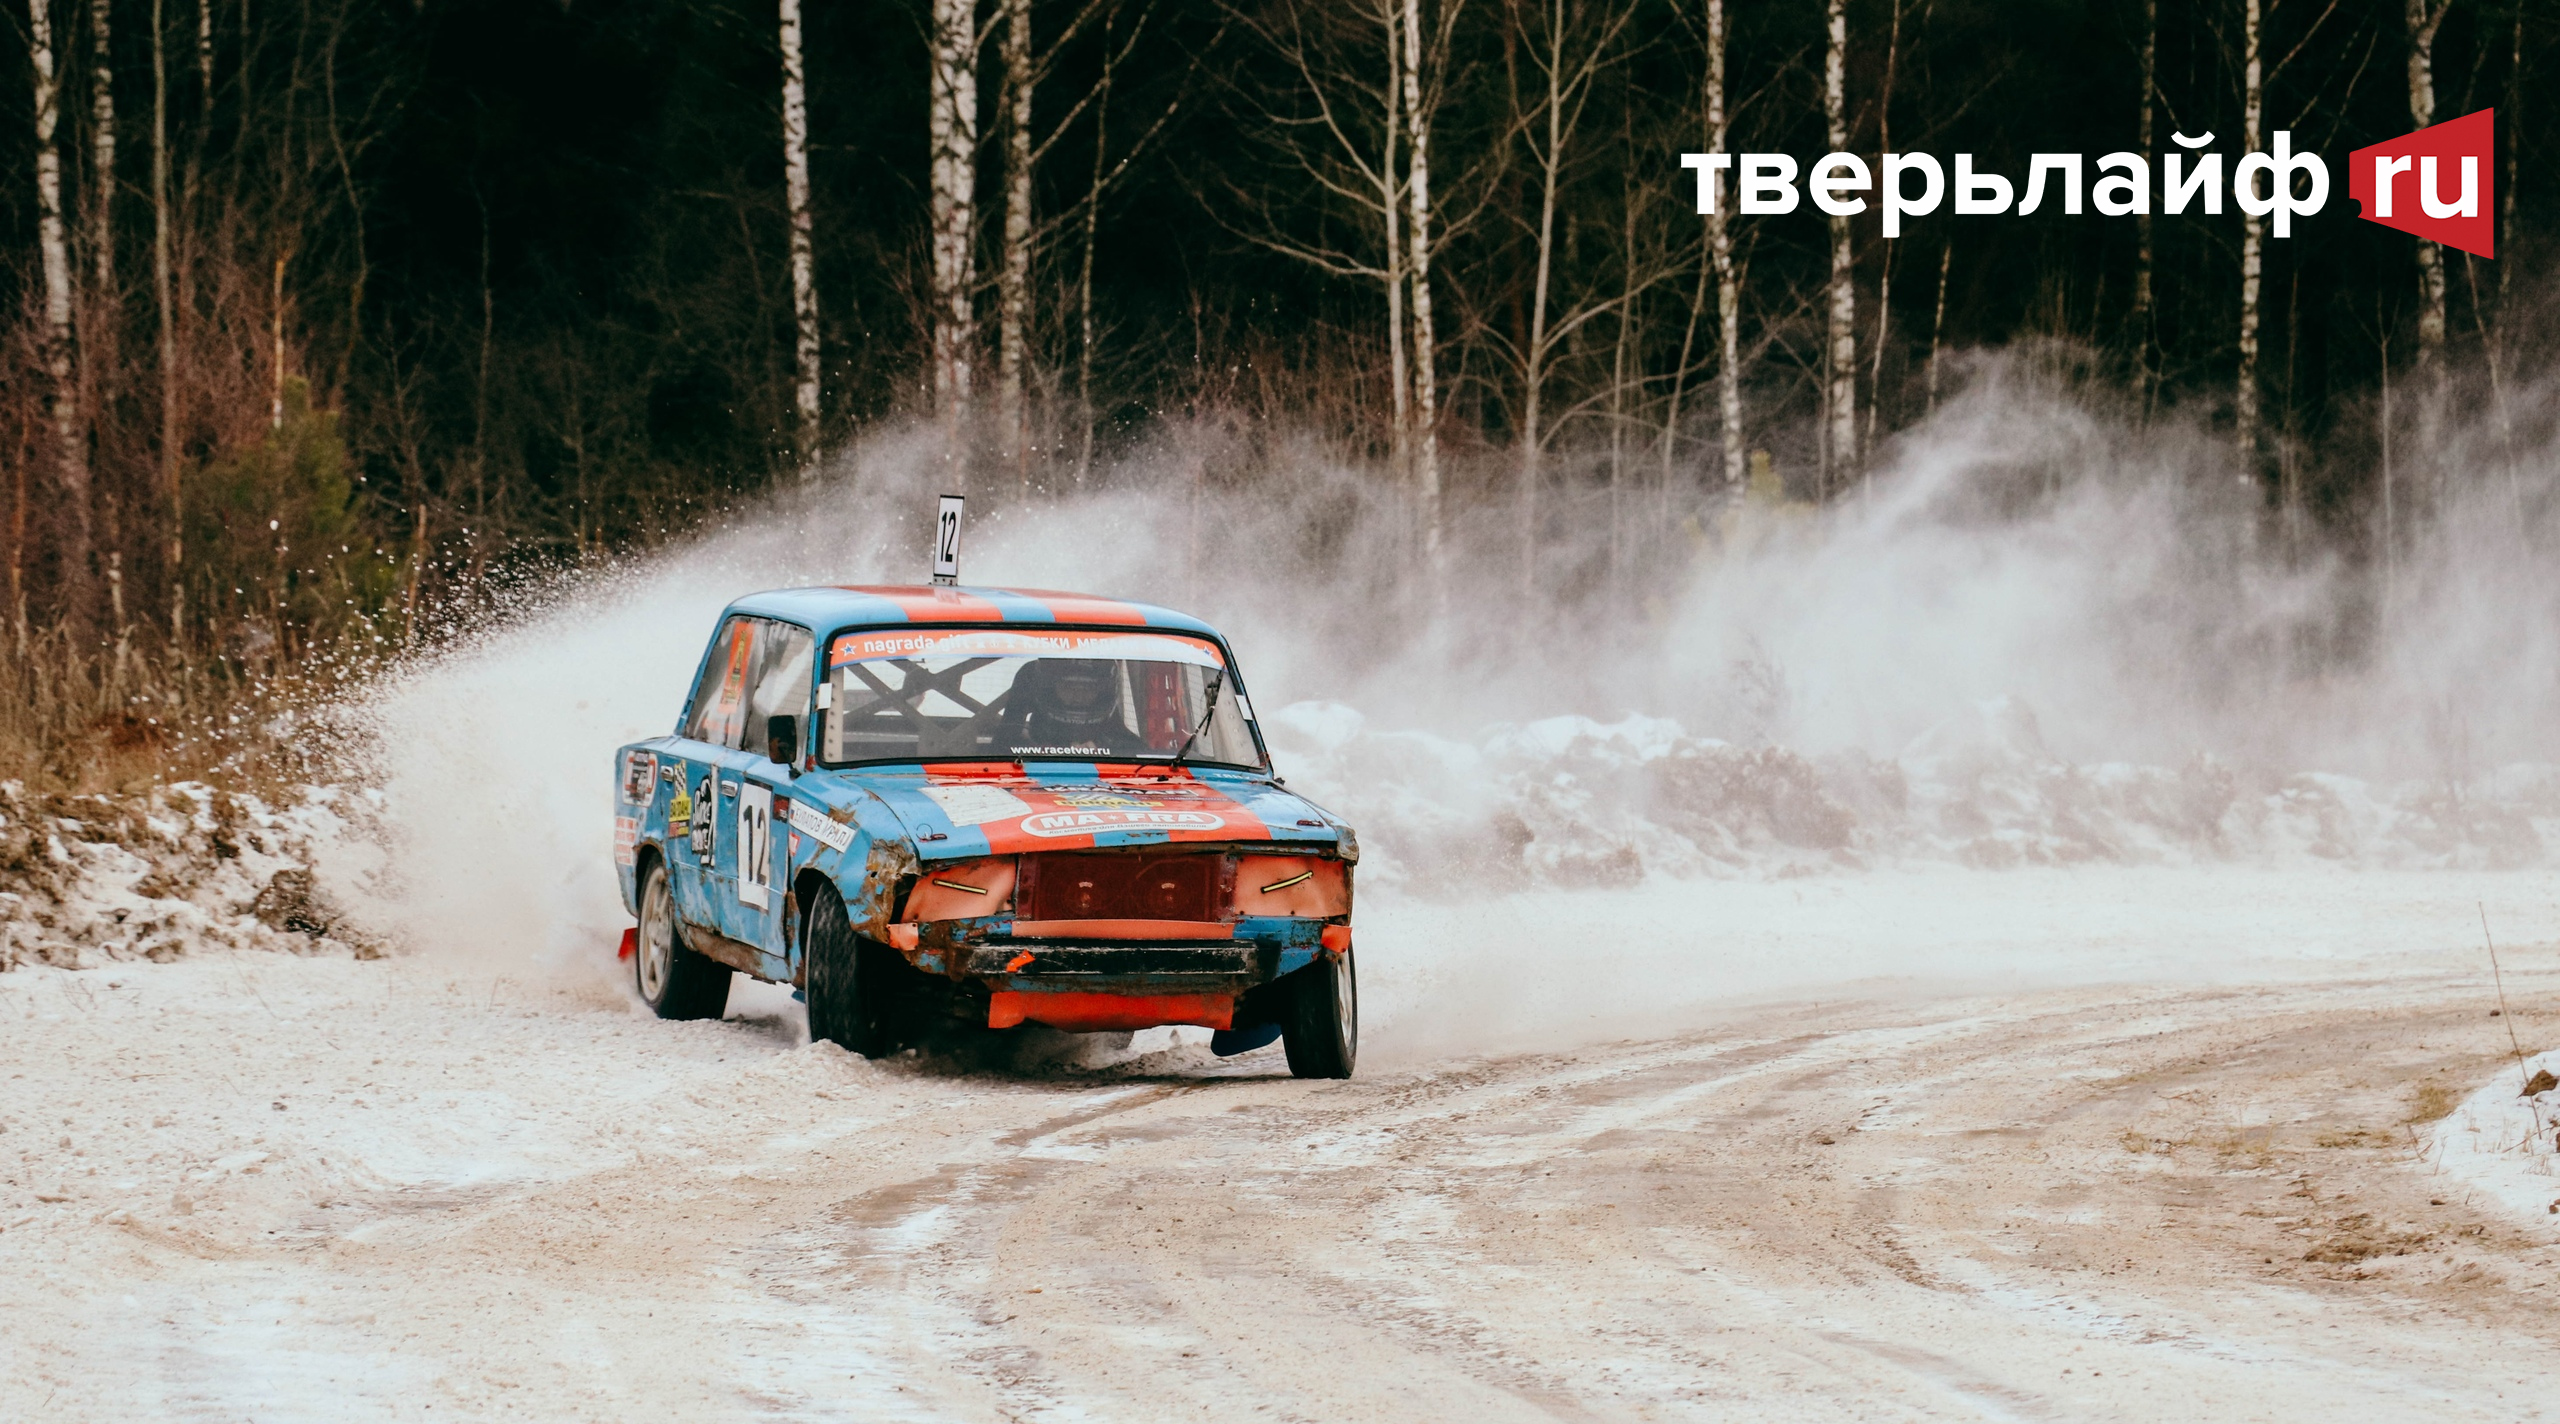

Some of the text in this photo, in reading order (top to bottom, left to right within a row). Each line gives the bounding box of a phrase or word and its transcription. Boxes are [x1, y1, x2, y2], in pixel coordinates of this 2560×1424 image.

[941, 511, 957, 562] 12
[1010, 745, 1111, 756] www.racetver.ru
[743, 804, 767, 886] 12
